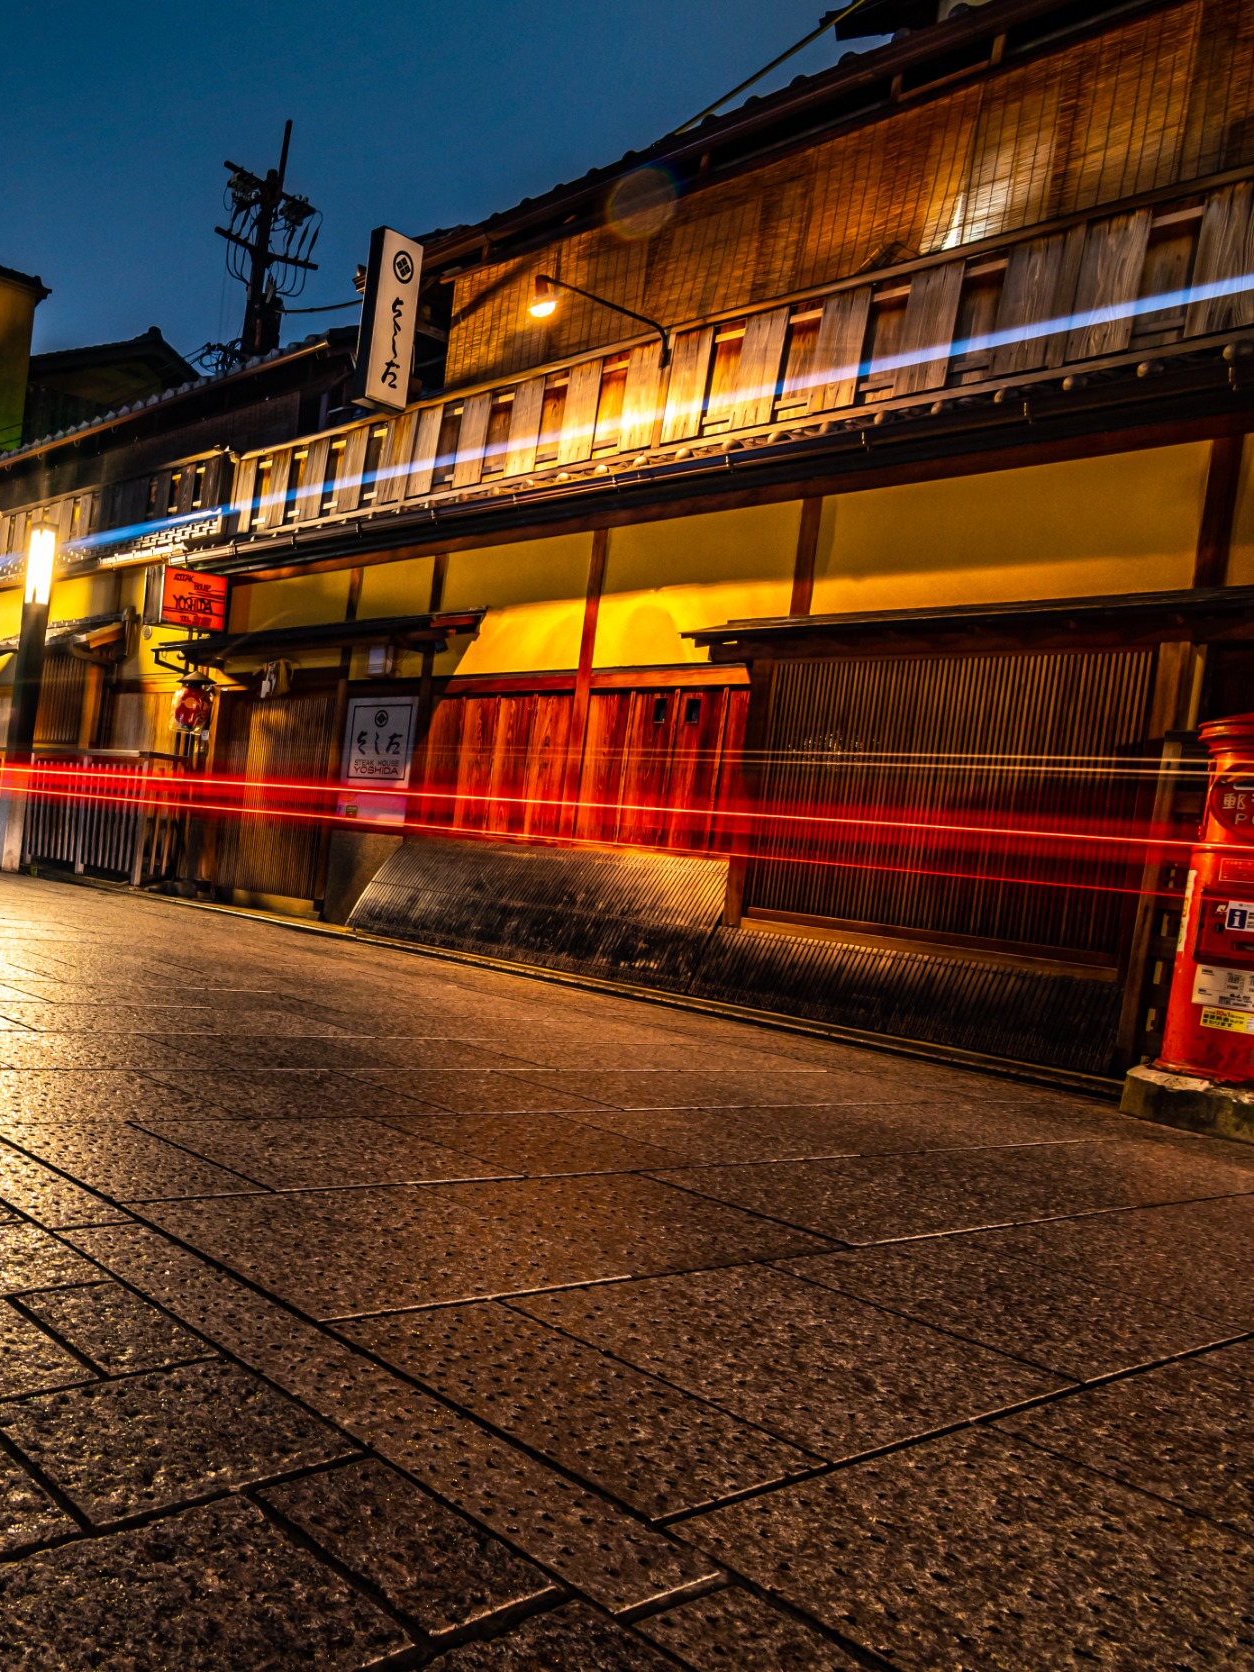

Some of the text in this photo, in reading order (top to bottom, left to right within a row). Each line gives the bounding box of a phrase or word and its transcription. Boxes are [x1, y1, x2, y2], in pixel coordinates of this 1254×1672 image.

[172, 594, 214, 615] YOSHIDA
[354, 759, 400, 768] STEAK HOUSE
[353, 766, 399, 776] YOSHIDA
